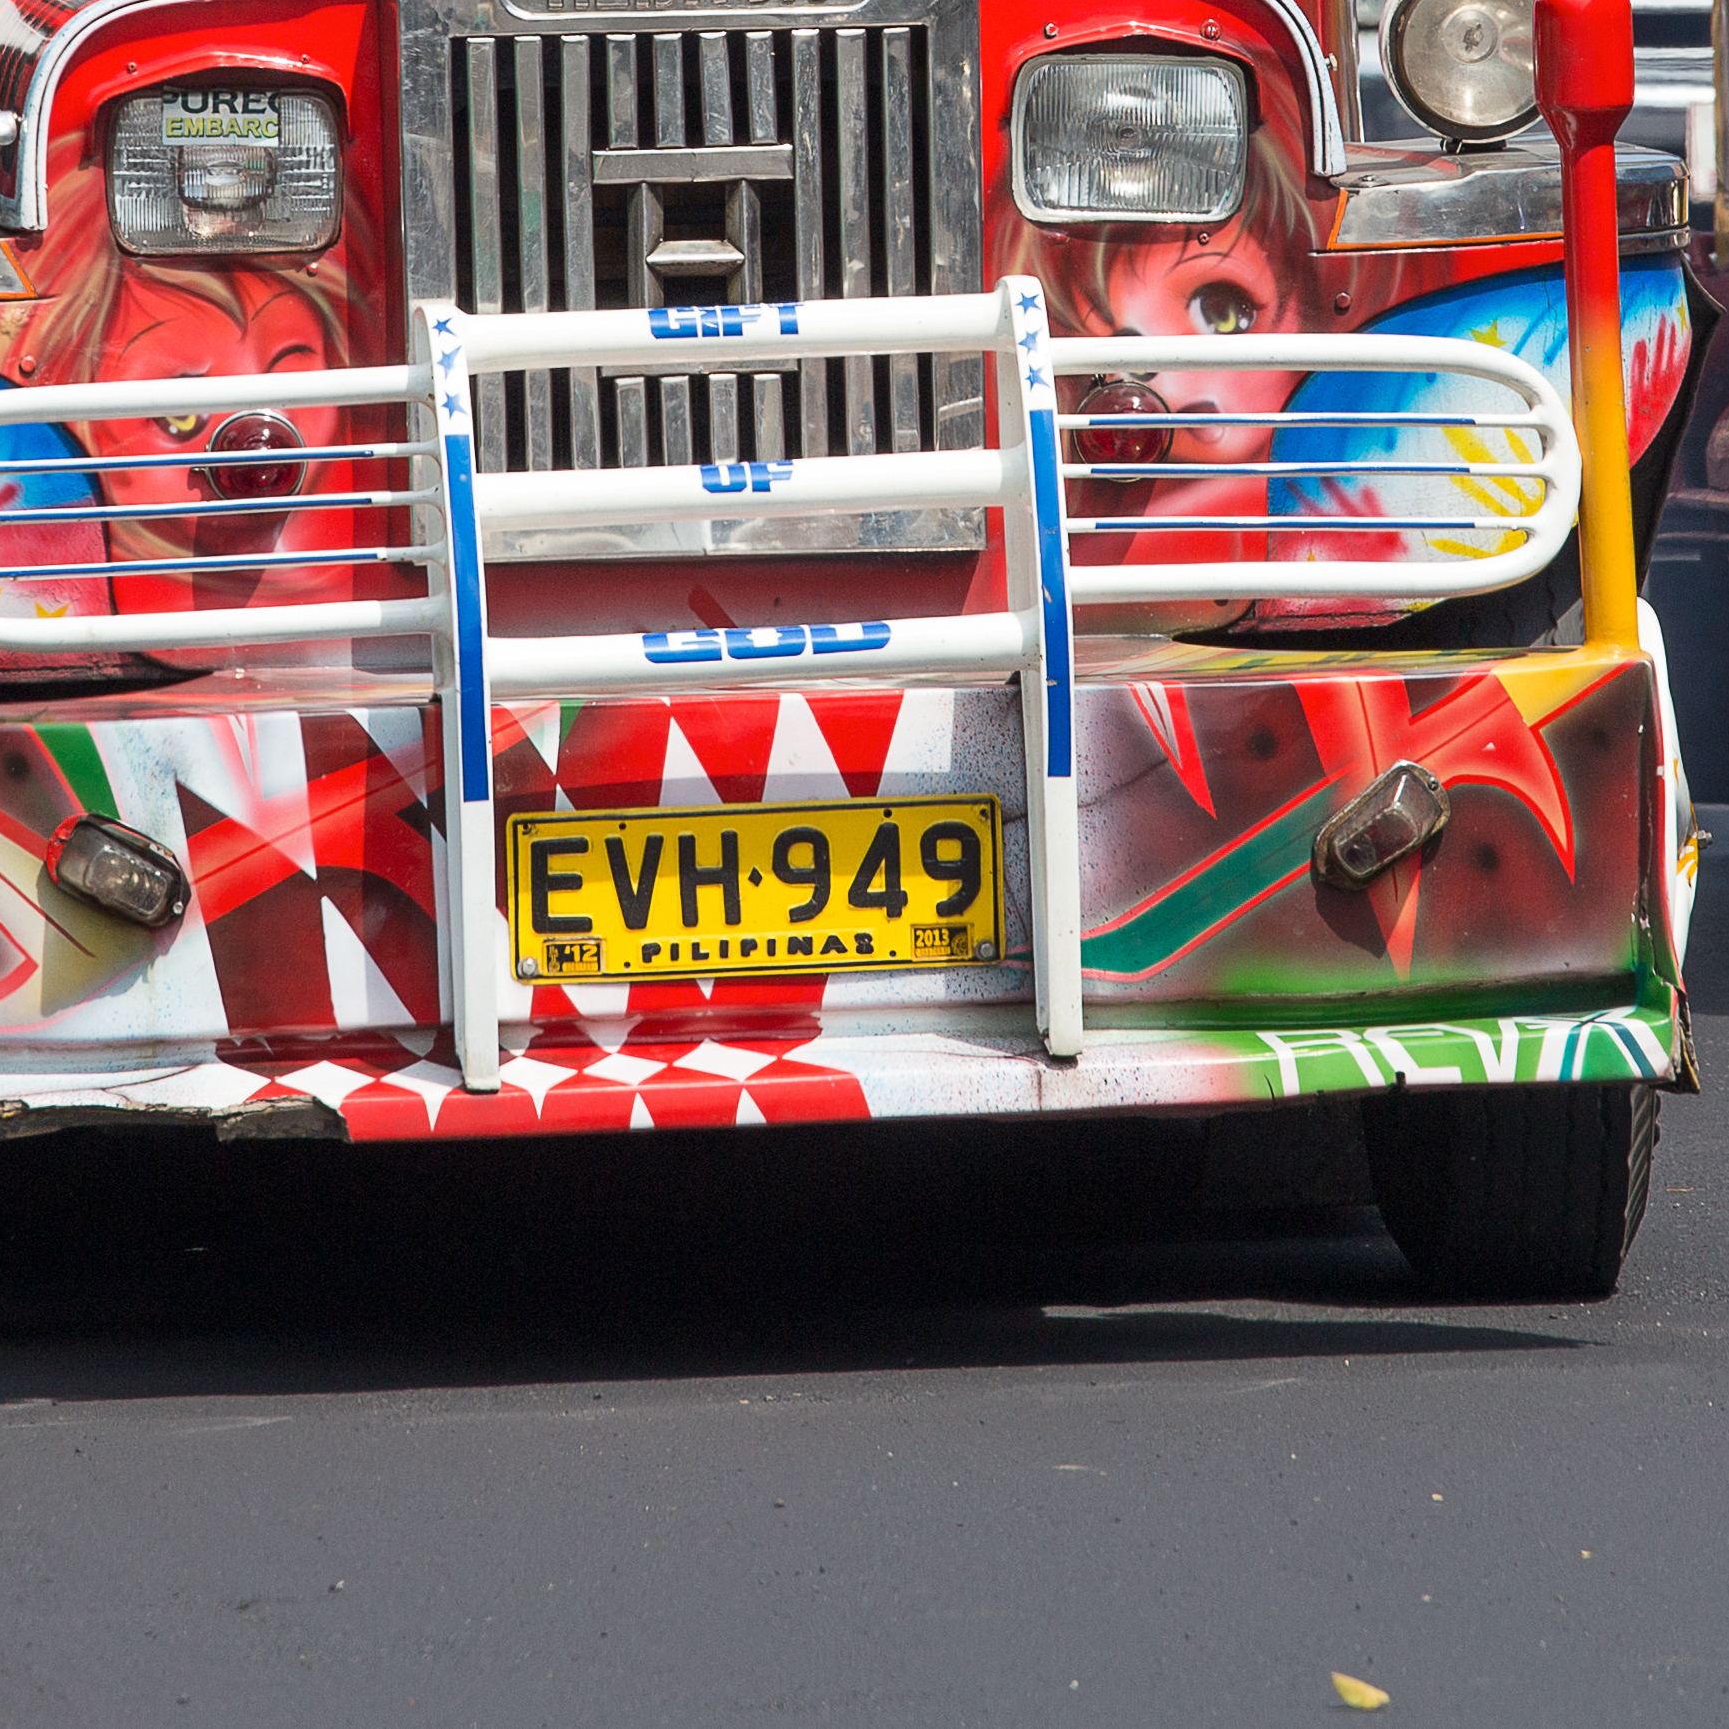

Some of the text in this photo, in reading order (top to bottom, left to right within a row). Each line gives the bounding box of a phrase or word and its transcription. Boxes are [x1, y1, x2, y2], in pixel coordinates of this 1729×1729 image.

[647, 301, 806, 340] GIFT
[641, 621, 892, 664] GOD
[641, 932, 876, 964] PILIPINAS
[915, 928, 950, 948] 2013
